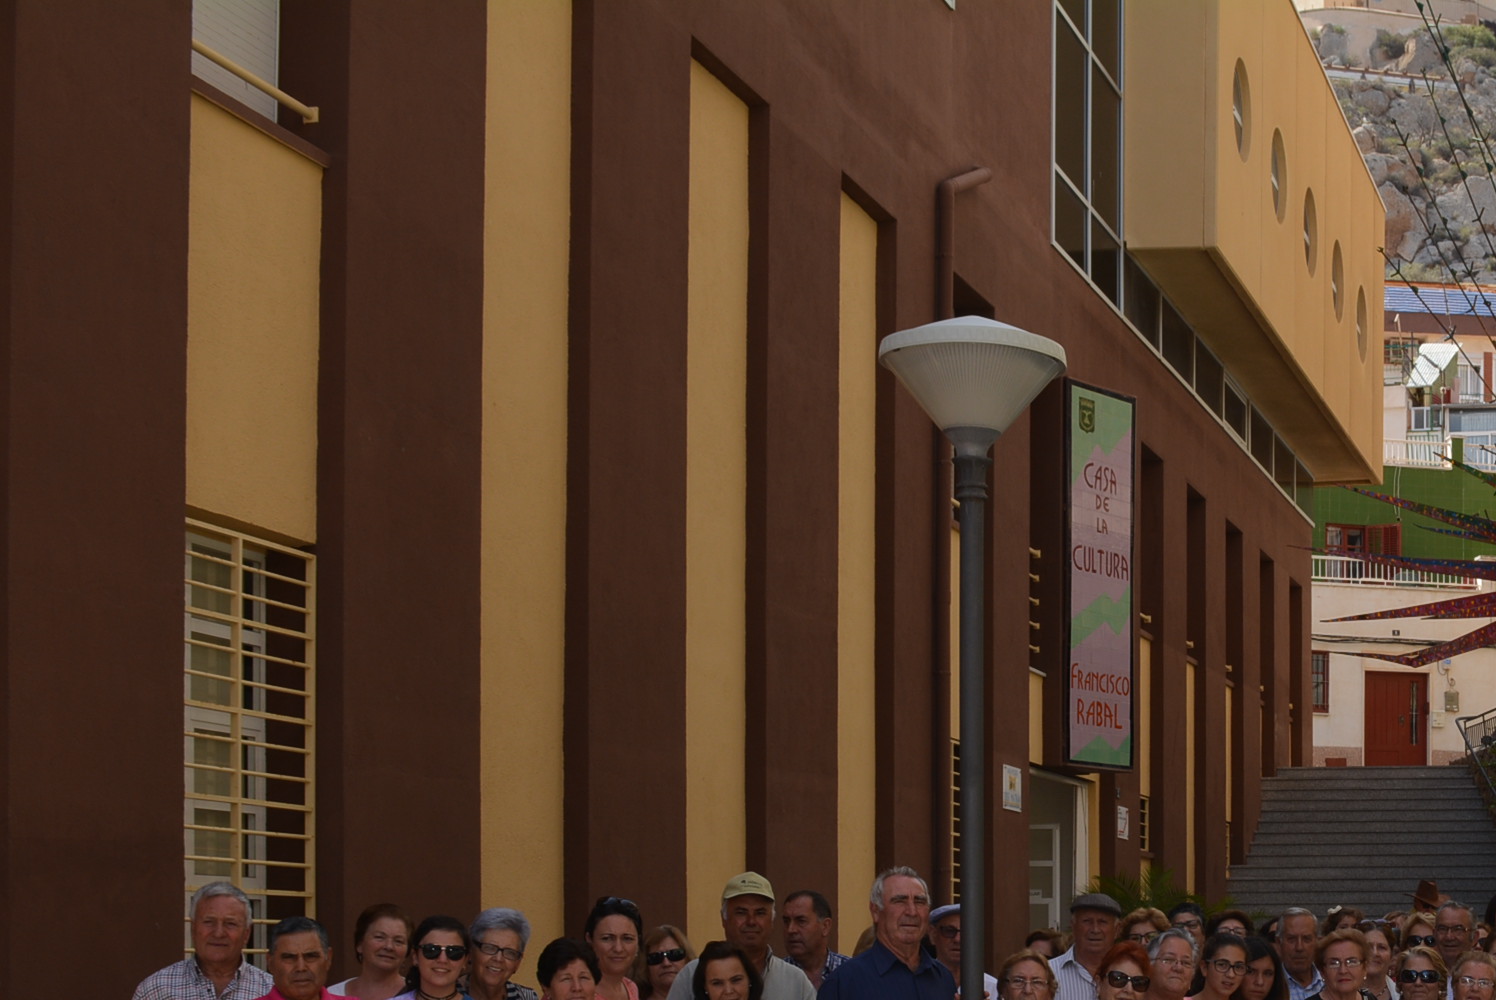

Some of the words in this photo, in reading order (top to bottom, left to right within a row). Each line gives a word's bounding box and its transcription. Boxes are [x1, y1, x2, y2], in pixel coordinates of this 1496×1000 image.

[1083, 462, 1117, 496] CASA
[1095, 494, 1110, 513] DE
[1096, 517, 1108, 535] LA
[1073, 544, 1129, 581] CULTURA
[1070, 662, 1130, 697] FRANCISCO
[1077, 698, 1123, 729] RABAL
